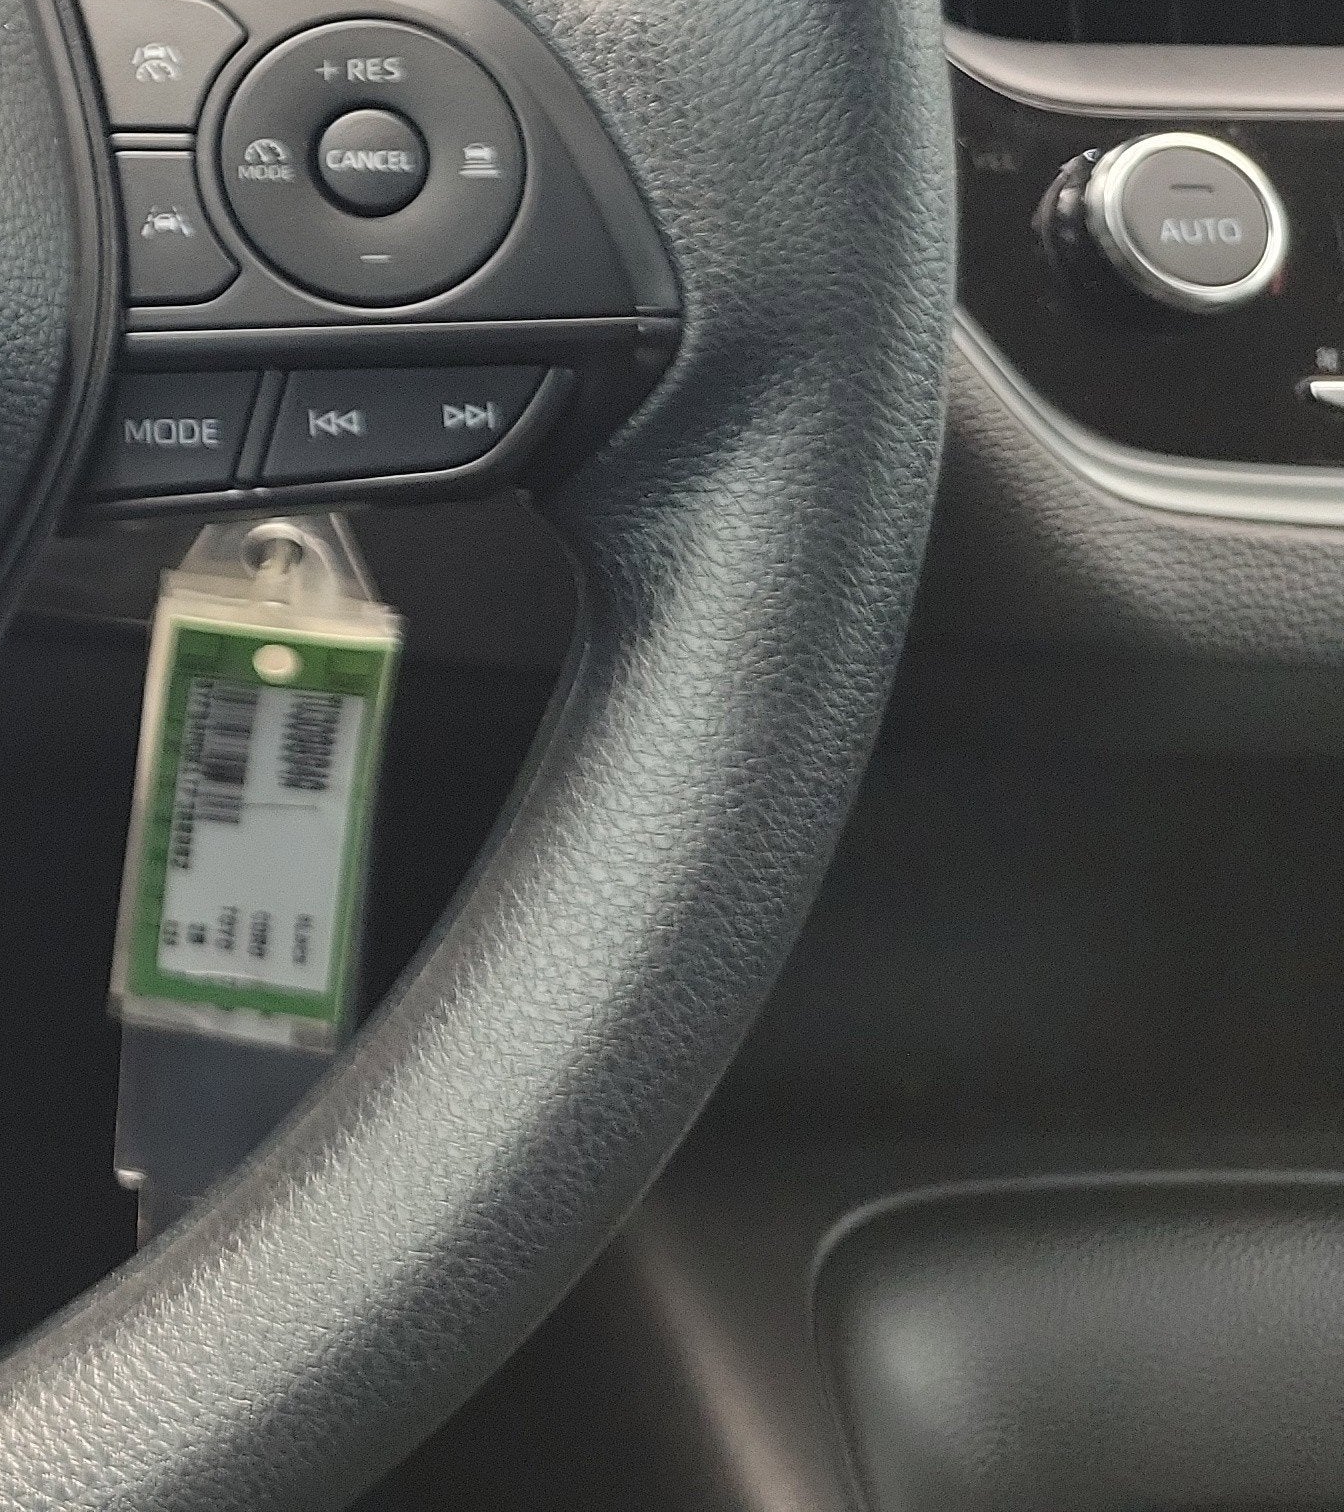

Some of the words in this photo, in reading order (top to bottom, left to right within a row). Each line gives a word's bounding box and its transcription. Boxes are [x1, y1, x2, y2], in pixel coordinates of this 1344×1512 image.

[237, 163, 295, 181] MODE
[325, 149, 415, 172] CANCEL
[1160, 217, 1242, 245] AUTO
[123, 417, 221, 445] MODE
